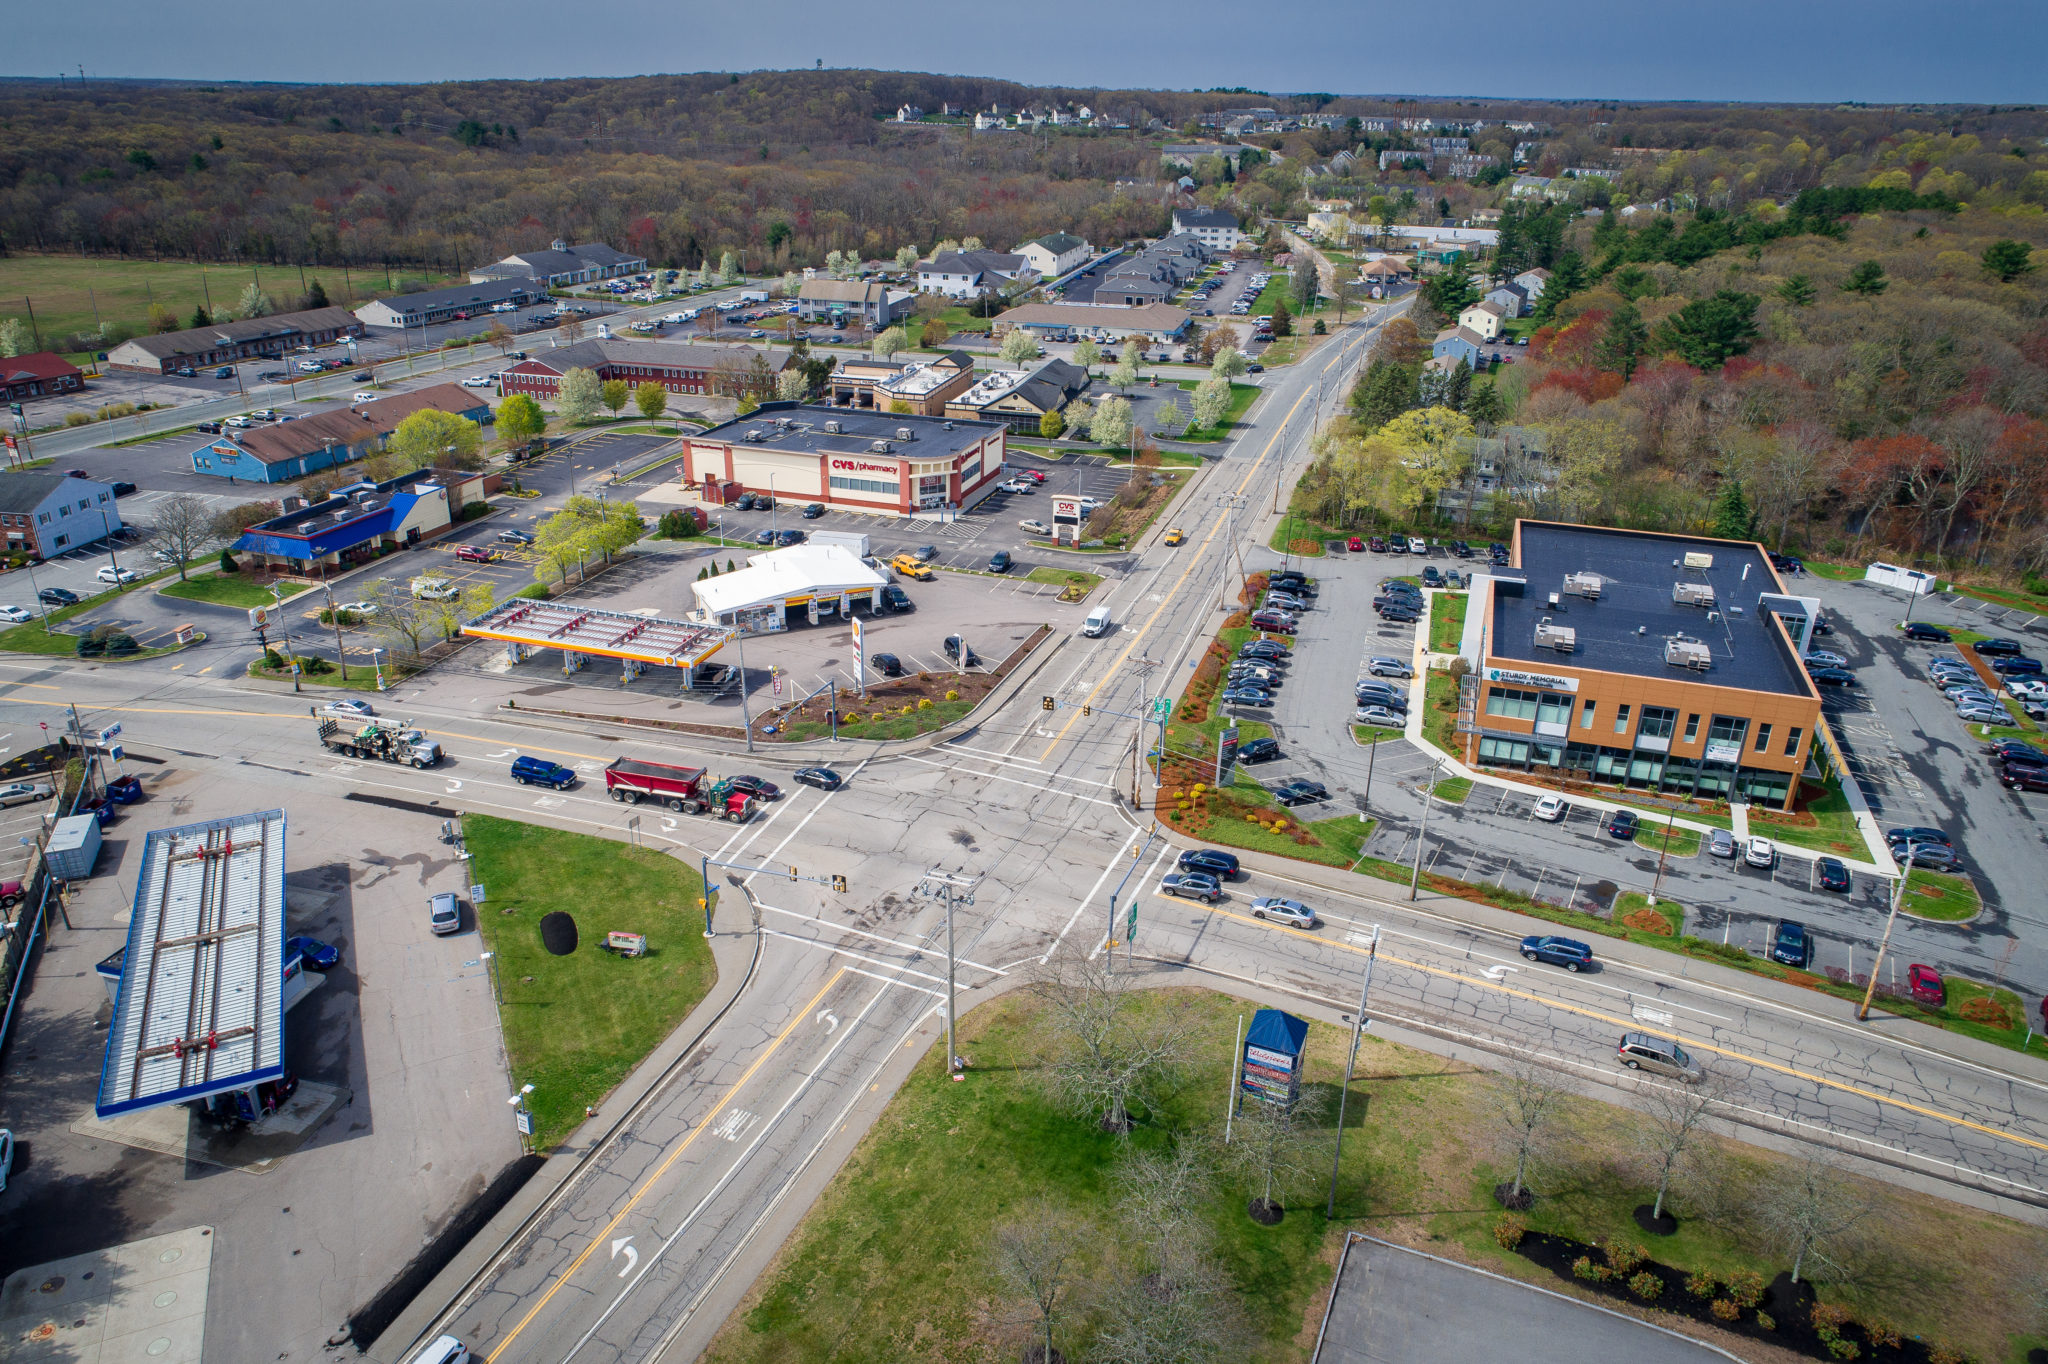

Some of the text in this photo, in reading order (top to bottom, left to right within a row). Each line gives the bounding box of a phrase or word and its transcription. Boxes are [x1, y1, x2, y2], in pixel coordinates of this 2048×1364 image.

[1058, 502, 1075, 510] CVS
[1500, 671, 1567, 685] STURDY MEMORIAL
[104, 725, 122, 741] Mobil
[1249, 1048, 1290, 1065] Walgreens
[711, 1108, 761, 1143] ONLY
